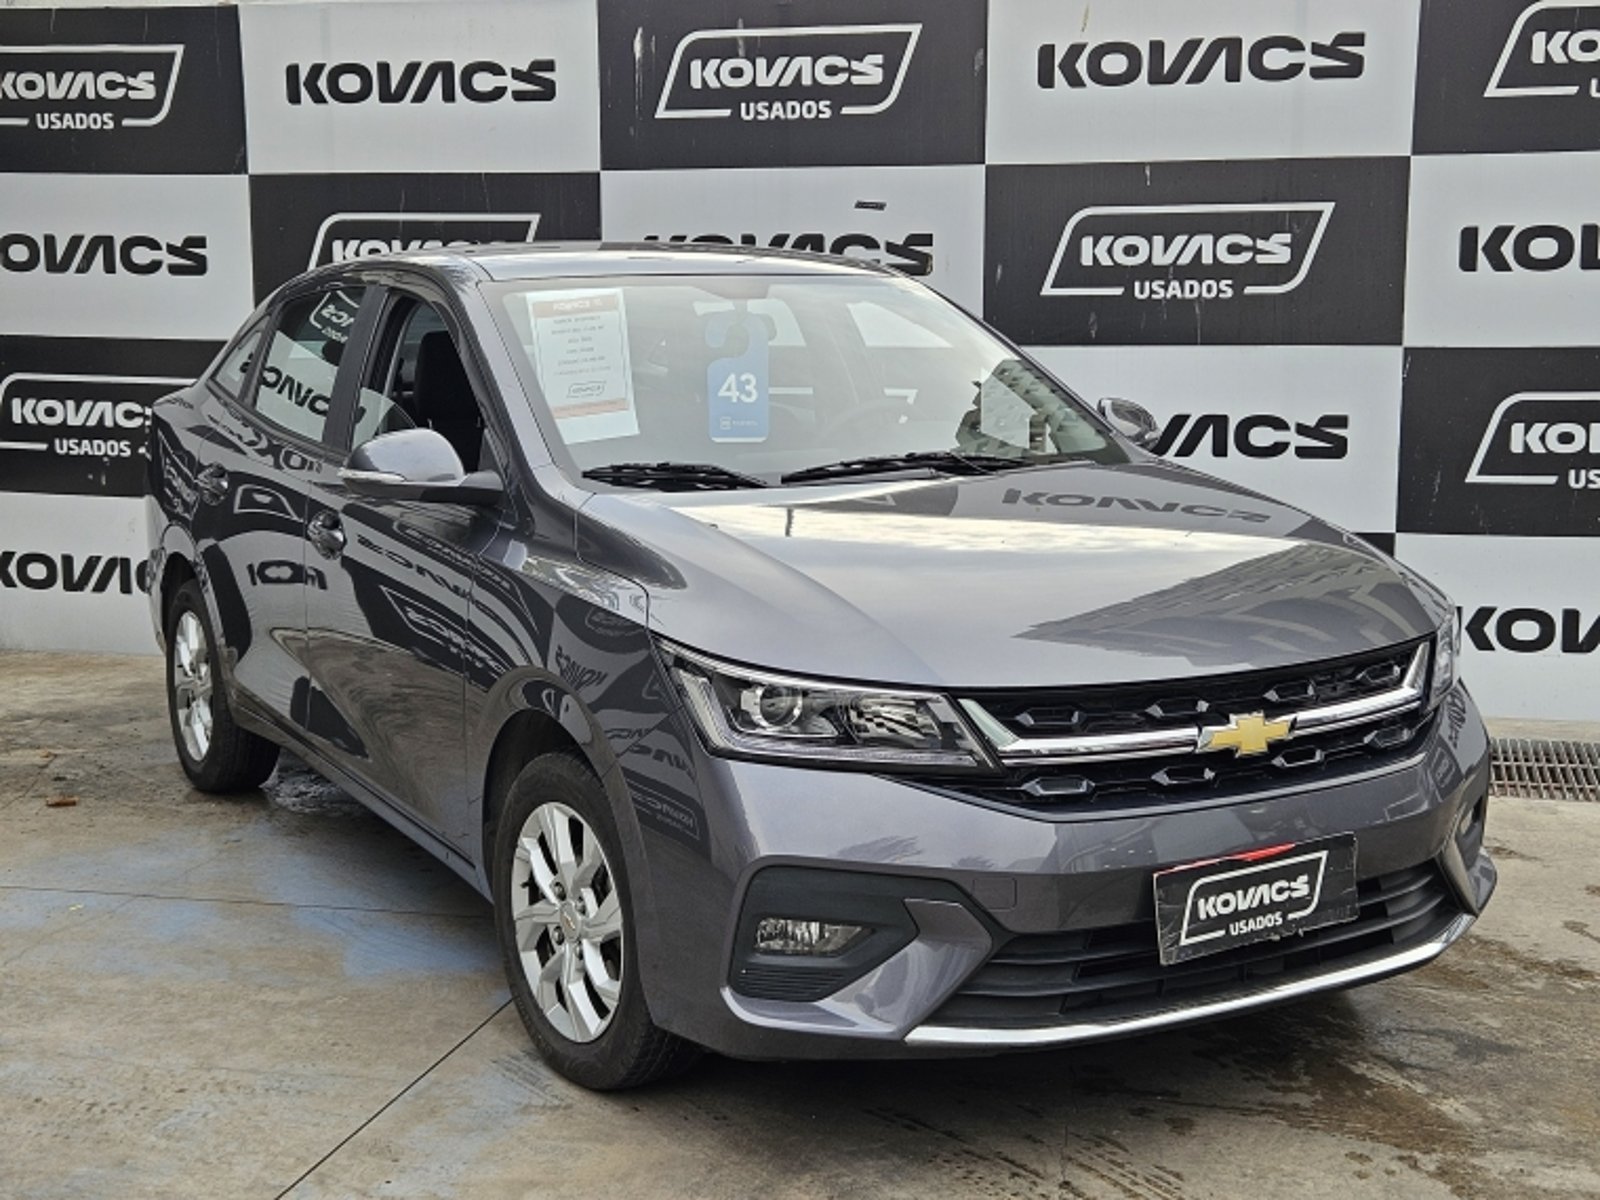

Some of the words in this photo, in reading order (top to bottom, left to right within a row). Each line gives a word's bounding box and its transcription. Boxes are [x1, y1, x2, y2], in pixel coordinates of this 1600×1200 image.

[690, 53, 883, 89] KOVACS
[1037, 31, 1365, 89] KOVACS
[286, 59, 556, 105] KOVACS
[36, 112, 114, 129] USADOS
[740, 100, 831, 120] USADOS
[1081, 233, 1291, 266] KOVACS
[1134, 279, 1233, 299] USADOS
[718, 372, 758, 403] 43
[12, 397, 152, 428] KOVAC
[54, 438, 131, 457] USADOS
[1198, 874, 1310, 920] KOVACS
[1229, 911, 1283, 936] USADOS
